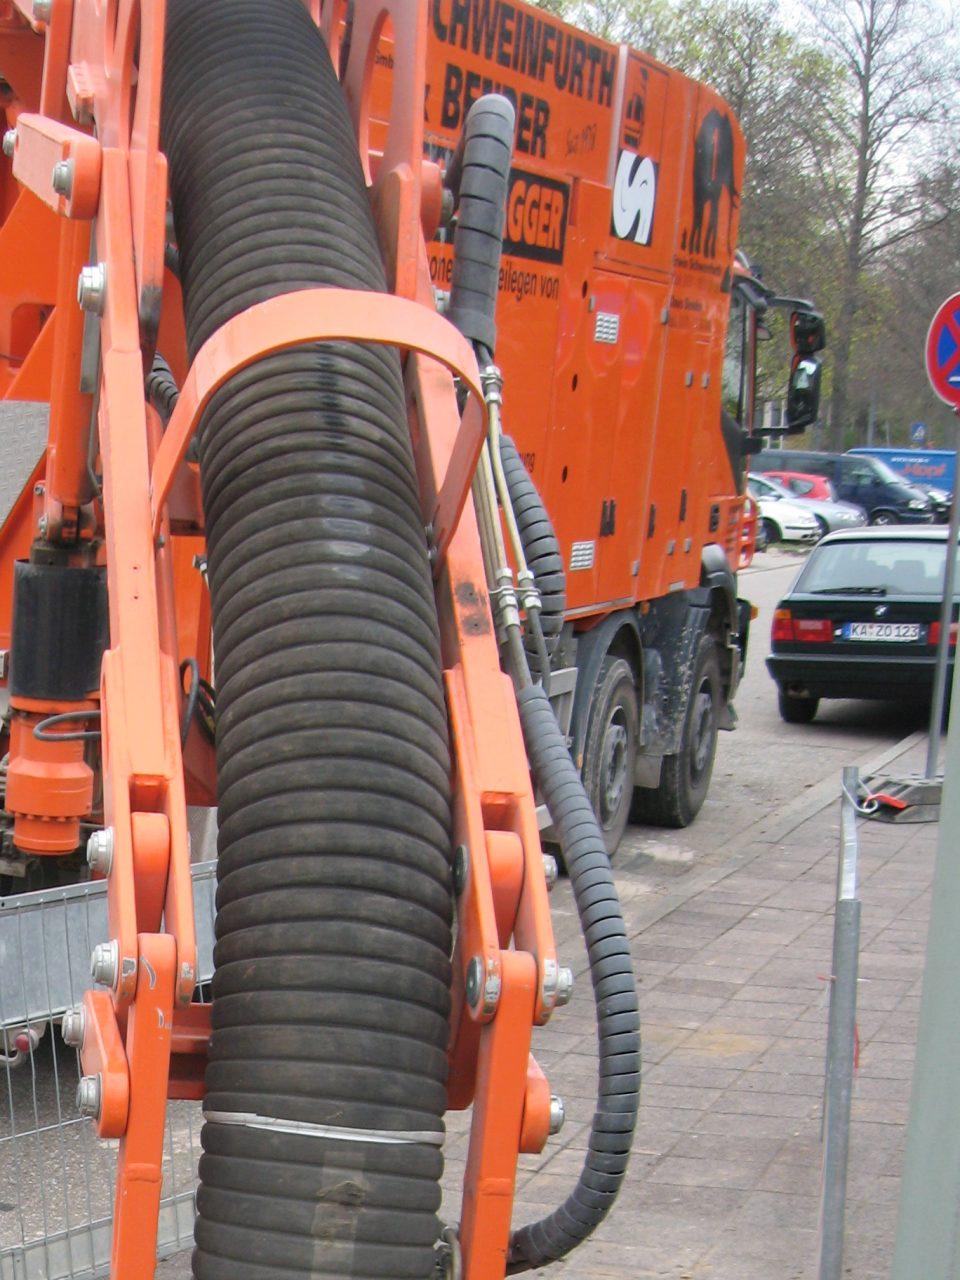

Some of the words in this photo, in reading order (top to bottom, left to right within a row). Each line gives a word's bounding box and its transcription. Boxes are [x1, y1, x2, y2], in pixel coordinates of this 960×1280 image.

[428, 0, 617, 108] CHWEINFURTH
[441, 62, 550, 159] BEDER
[503, 180, 564, 250] GGER
[498, 260, 537, 302] eilegen
[540, 274, 560, 300] von
[852, 624, 867, 637] KA
[895, 626, 919, 638] 123
